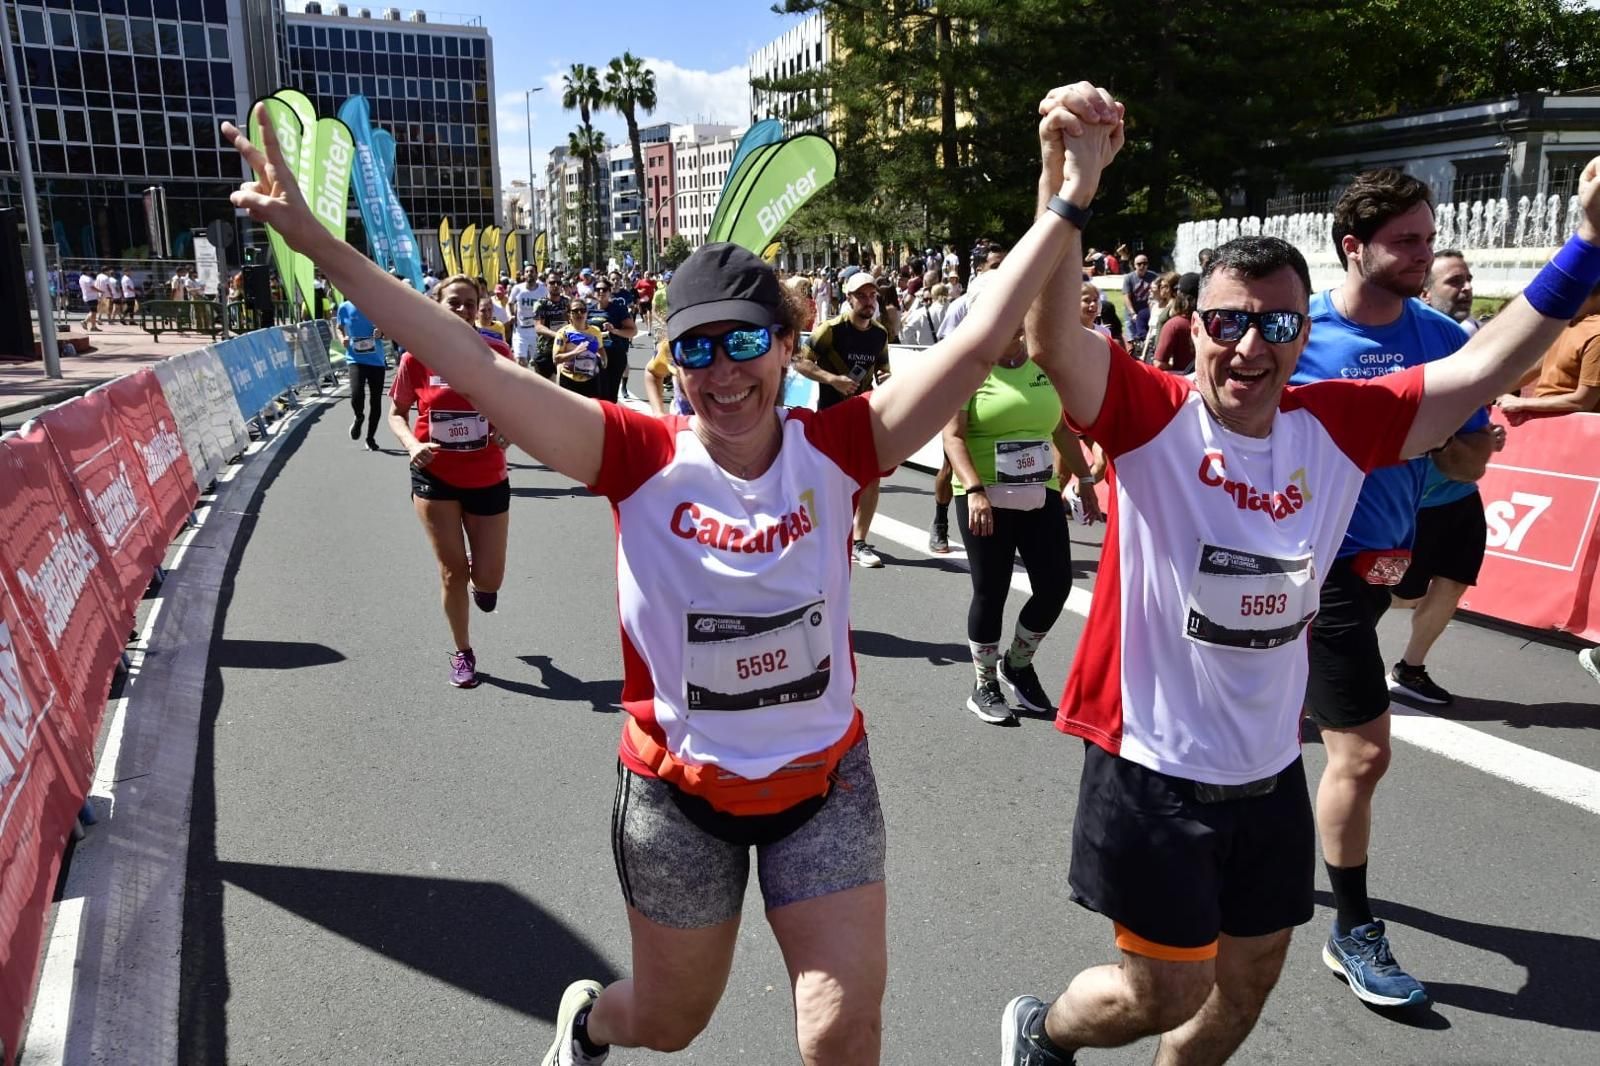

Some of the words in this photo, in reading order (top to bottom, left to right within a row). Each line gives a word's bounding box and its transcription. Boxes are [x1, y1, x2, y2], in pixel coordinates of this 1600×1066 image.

[317, 128, 350, 227] Binter
[357, 140, 384, 226] cajamar
[756, 167, 816, 237] Binter
[1360, 353, 1404, 364] GRUPO
[670, 488, 819, 553] Canarias7
[1240, 593, 1287, 616] 5593
[736, 649, 789, 679] 5592
